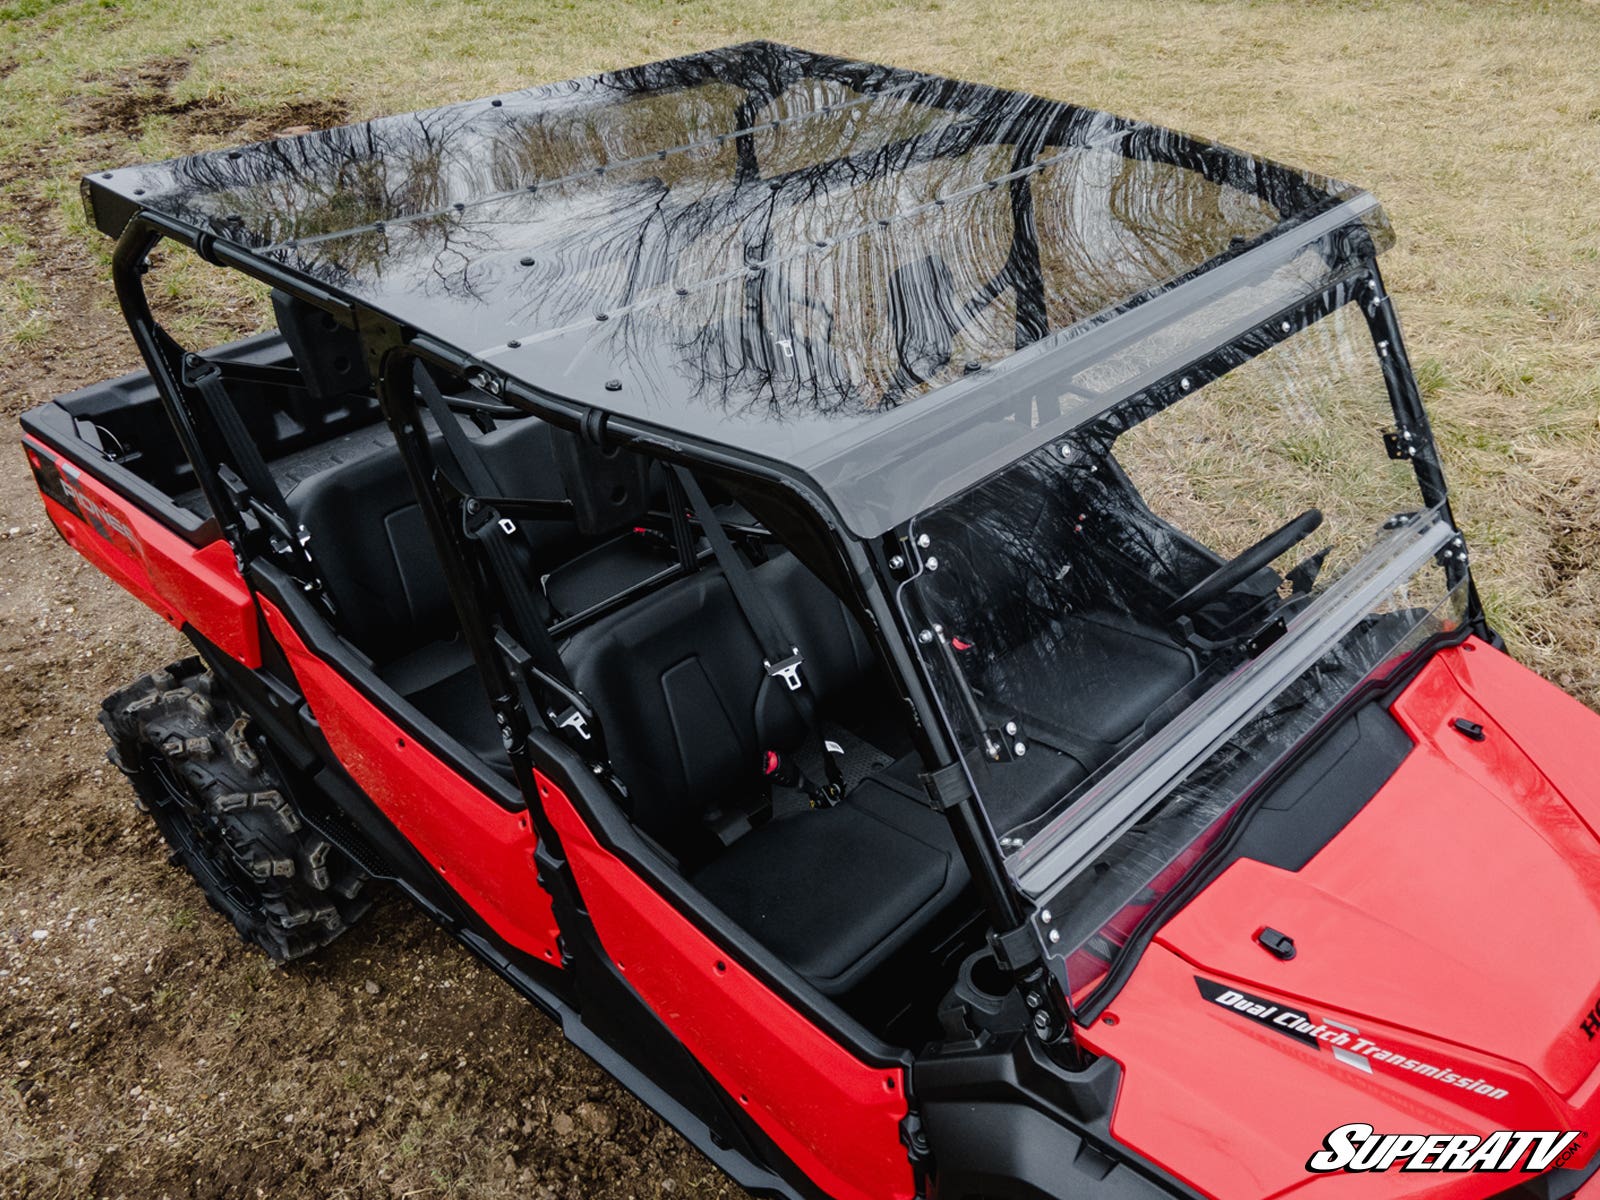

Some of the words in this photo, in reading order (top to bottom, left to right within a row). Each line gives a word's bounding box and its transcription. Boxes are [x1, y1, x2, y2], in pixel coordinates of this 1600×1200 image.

[1215, 990, 1278, 1019] Dual
[1272, 1011, 1351, 1046] Clutch
[1350, 1037, 1509, 1100] Transmission
